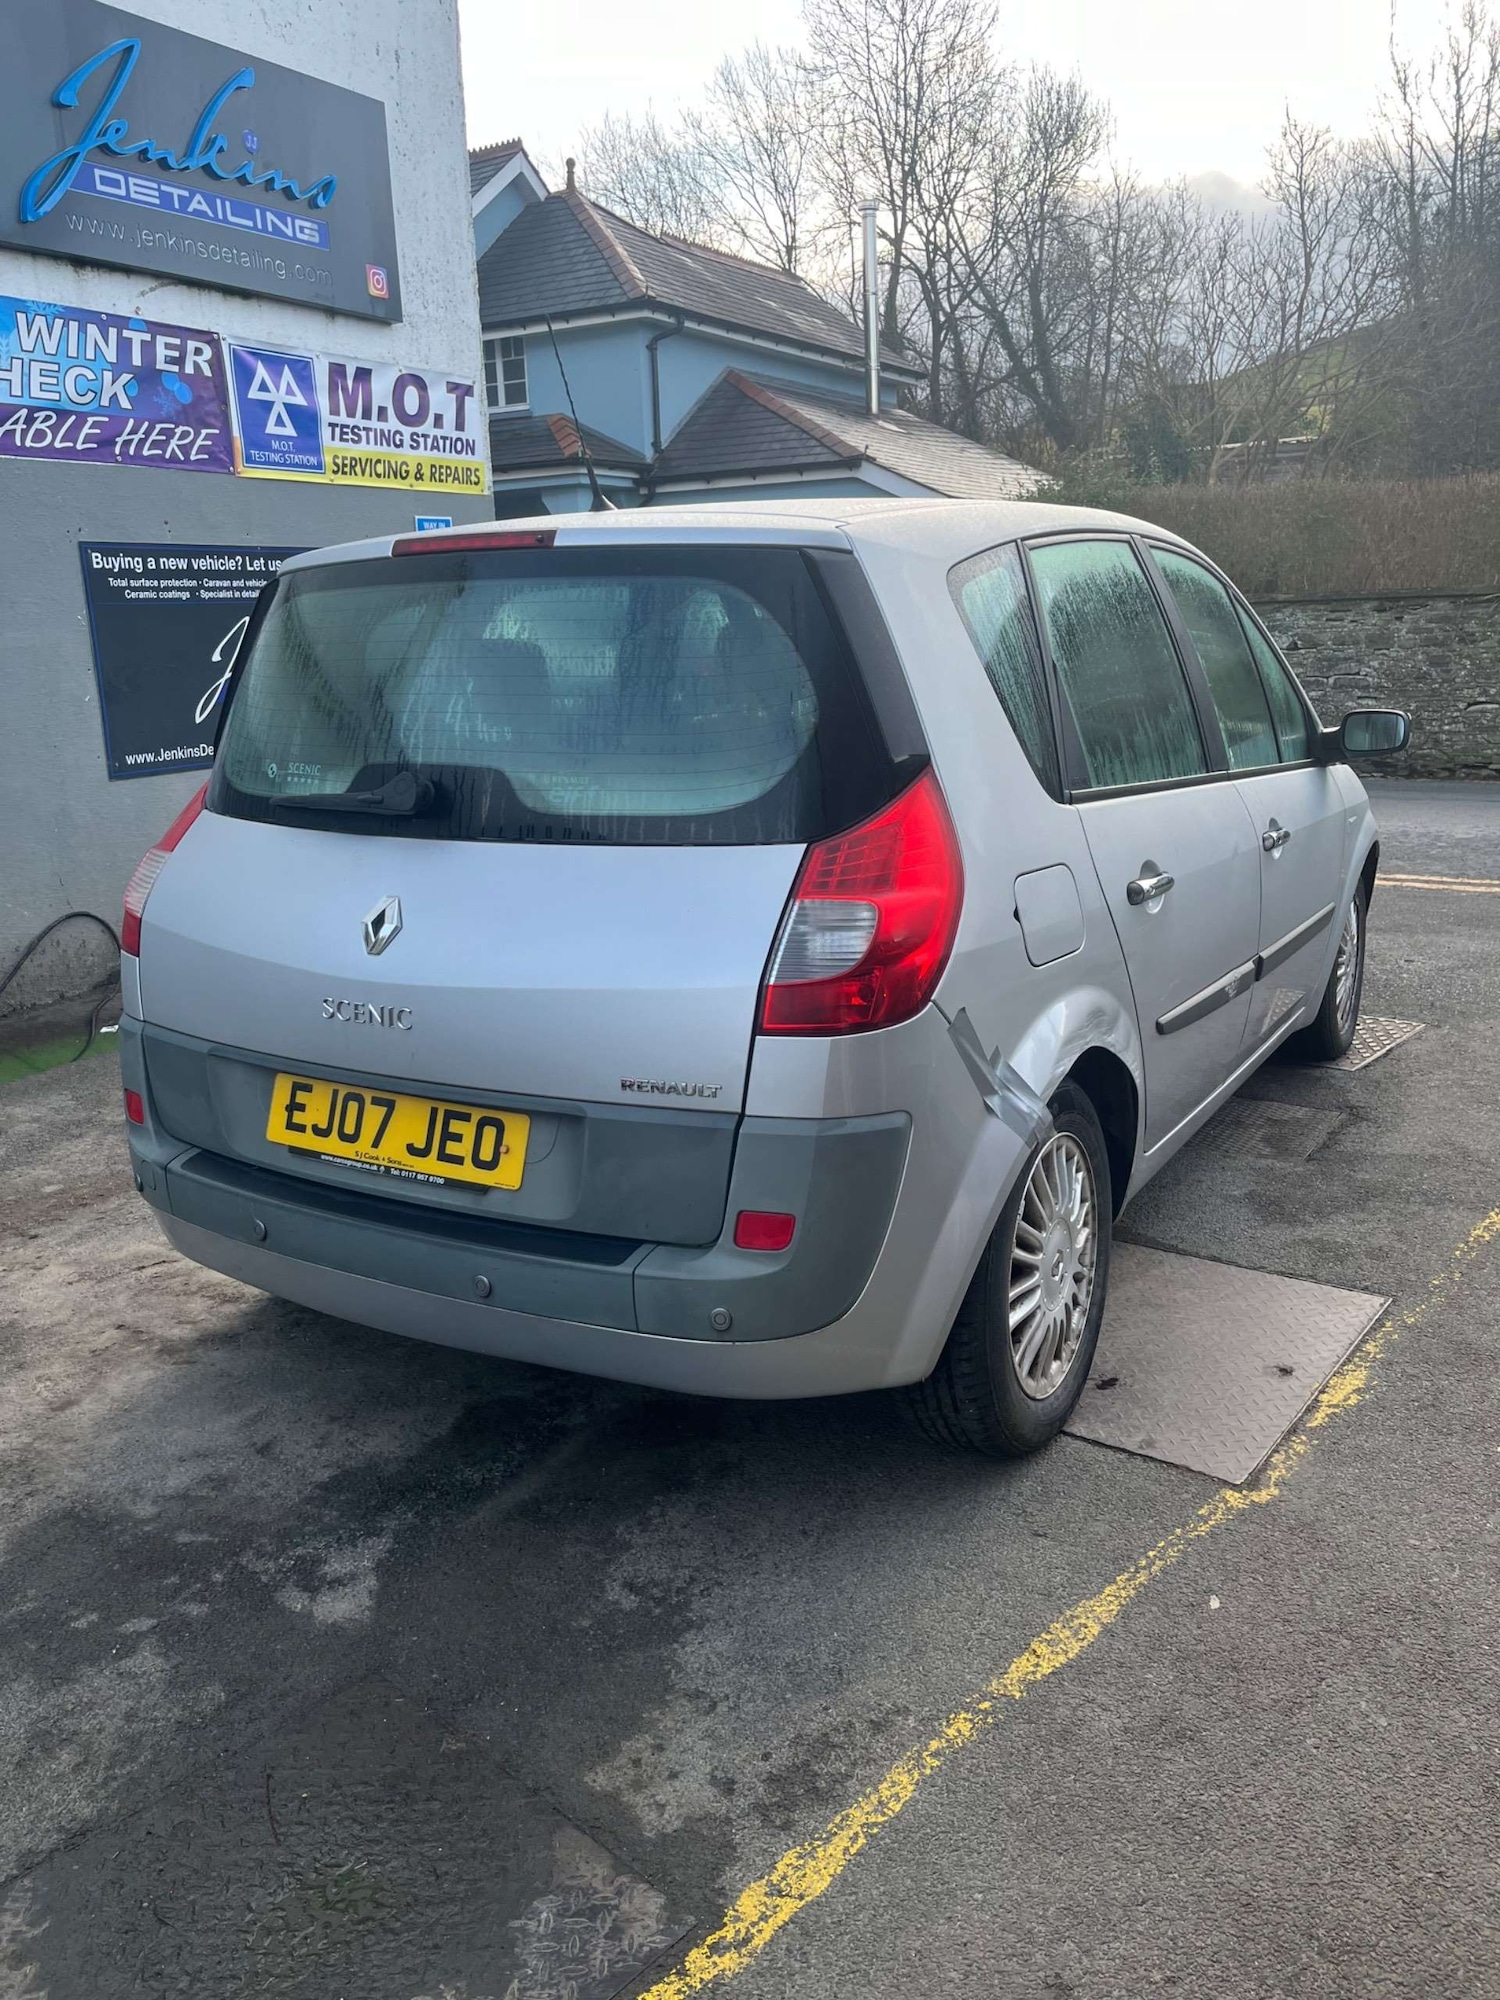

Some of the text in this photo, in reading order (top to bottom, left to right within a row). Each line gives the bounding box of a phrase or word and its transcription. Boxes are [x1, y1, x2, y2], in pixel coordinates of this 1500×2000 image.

[20, 37, 338, 223] Jenkins
[93, 167, 321, 245] DETAILING
[65, 212, 333, 286] www.jenkinsdetailing.com
[15, 311, 213, 377] WINTER
[328, 361, 475, 432] M.O.T
[115, 418, 220, 461] HERE
[271, 439, 297, 452] M.O.T.
[328, 422, 476, 456] TESTING STATION
[250, 450, 318, 467] TESTING STATION
[331, 454, 481, 486] SERVICING & REPAIRS
[91, 551, 282, 573] Buying a new vehicle? Let us
[108, 577, 129, 588] Total
[129, 577, 158, 588] surface
[160, 577, 198, 590] protection
[203, 578, 231, 588] Caravan
[232, 578, 245, 588] and
[124, 589, 158, 600] Ceramic
[159, 590, 191, 601] coatings
[200, 589, 233, 600] Specialist
[234, 589, 241, 599] in
[287, 762, 321, 776] SCENIC
[321, 997, 413, 1031] SCENIC
[619, 1076, 723, 1099] RENAULT
[284, 1080, 506, 1171] EJ07 JEO
[363, 1152, 380, 1162] Cook
